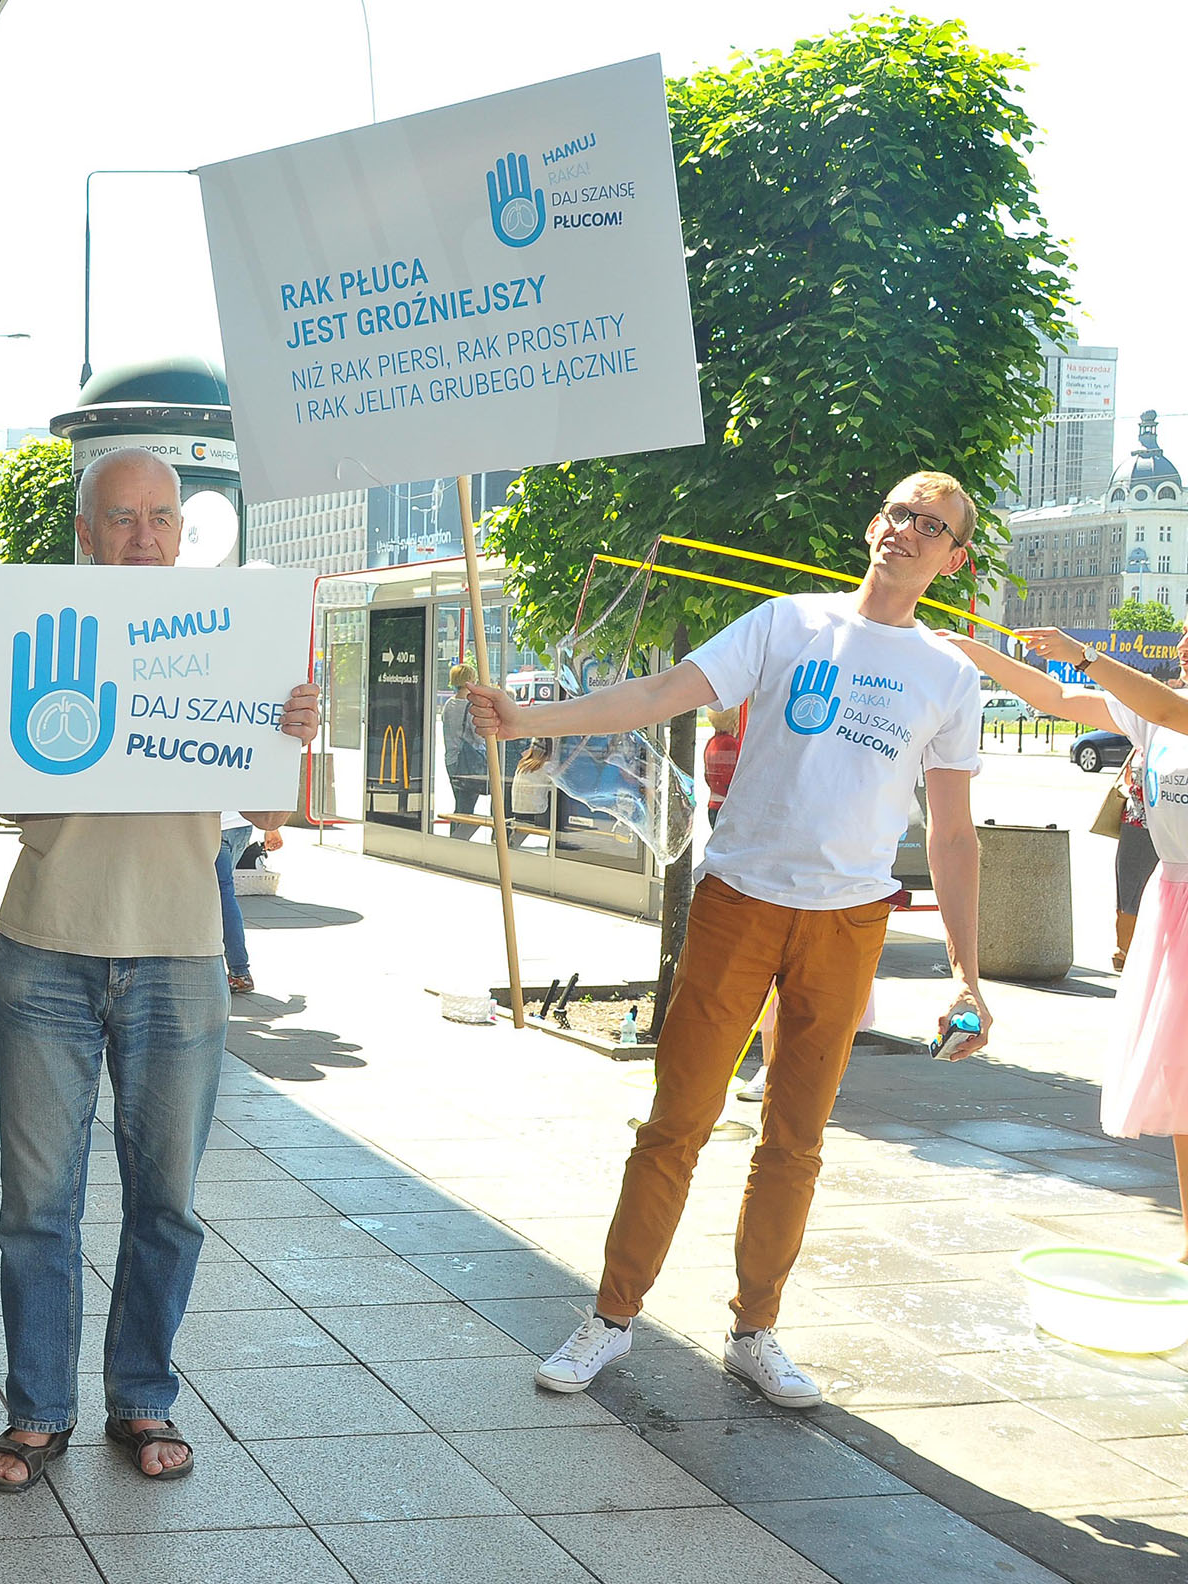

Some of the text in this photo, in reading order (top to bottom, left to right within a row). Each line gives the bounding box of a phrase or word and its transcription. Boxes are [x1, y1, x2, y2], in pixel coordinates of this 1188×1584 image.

[542, 132, 596, 166] HAMUJ
[548, 161, 590, 186] RAKA!
[551, 181, 635, 206] DAJ SZANSĘ
[553, 211, 623, 229] PŁUCOM!
[280, 257, 429, 311] RAK PŁUCA
[286, 274, 546, 350] JEST GROŹNIEJSZY
[291, 312, 625, 392] NIŻ RAK PIERSI, RAK PROSTATY
[295, 347, 639, 424] I RAK JELITA GRUBEGO ŁĄCZNIE
[127, 607, 231, 646] HAMUJ
[396, 651, 416, 663] 400 m
[1095, 641, 1108, 652] OD
[1110, 633, 1117, 652] 1
[1119, 642, 1132, 652] DO
[1133, 634, 1145, 653] 4
[132, 653, 210, 681] RAKA!
[852, 674, 903, 692] HAMUJ
[131, 694, 285, 732] DAJ SZANSĘ
[848, 690, 891, 709] RAKA!
[843, 707, 870, 725] DAJ
[126, 733, 253, 770] PŁUCOM!
[836, 725, 899, 761] PŁUCOM!
